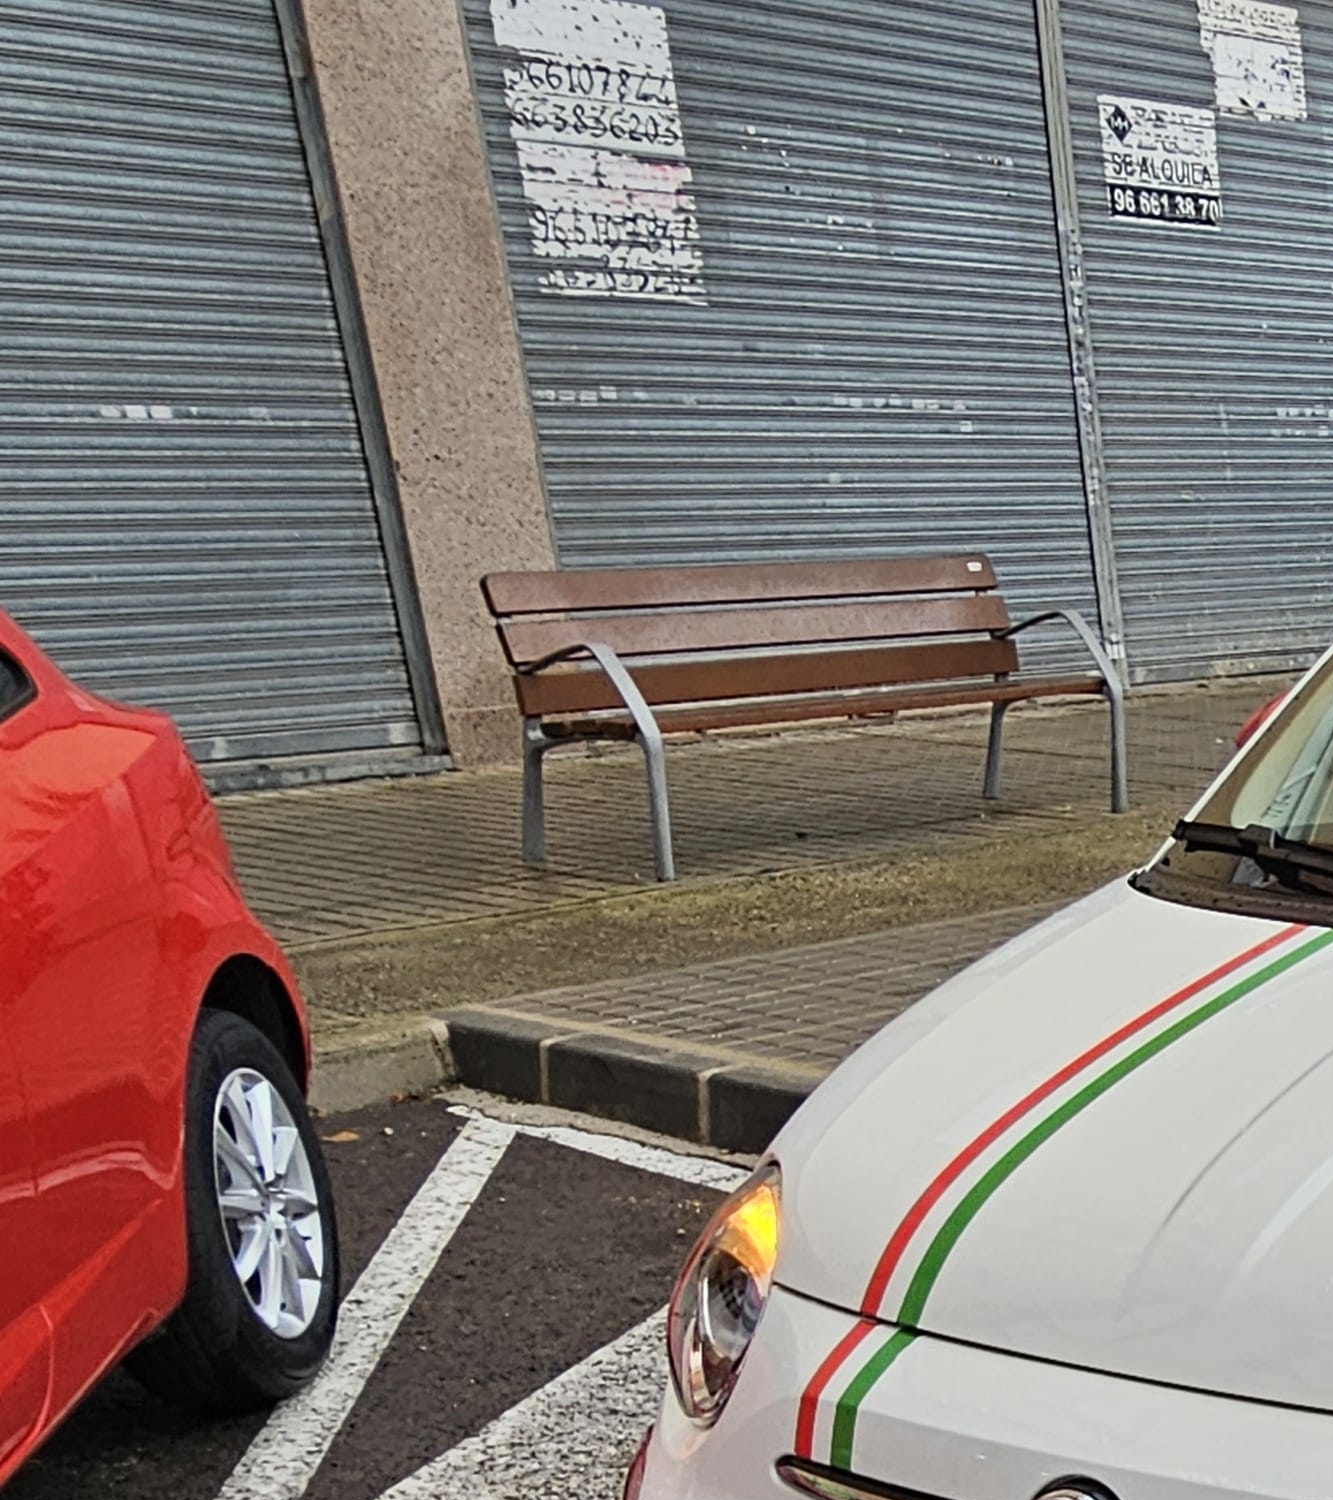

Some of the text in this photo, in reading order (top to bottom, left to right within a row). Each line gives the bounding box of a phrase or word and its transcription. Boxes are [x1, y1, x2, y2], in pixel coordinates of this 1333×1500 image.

[1112, 152, 1136, 177] SE
[1113, 188, 1136, 213] 96
[1139, 190, 1169, 216] 661
[1198, 198, 1219, 222] 70
